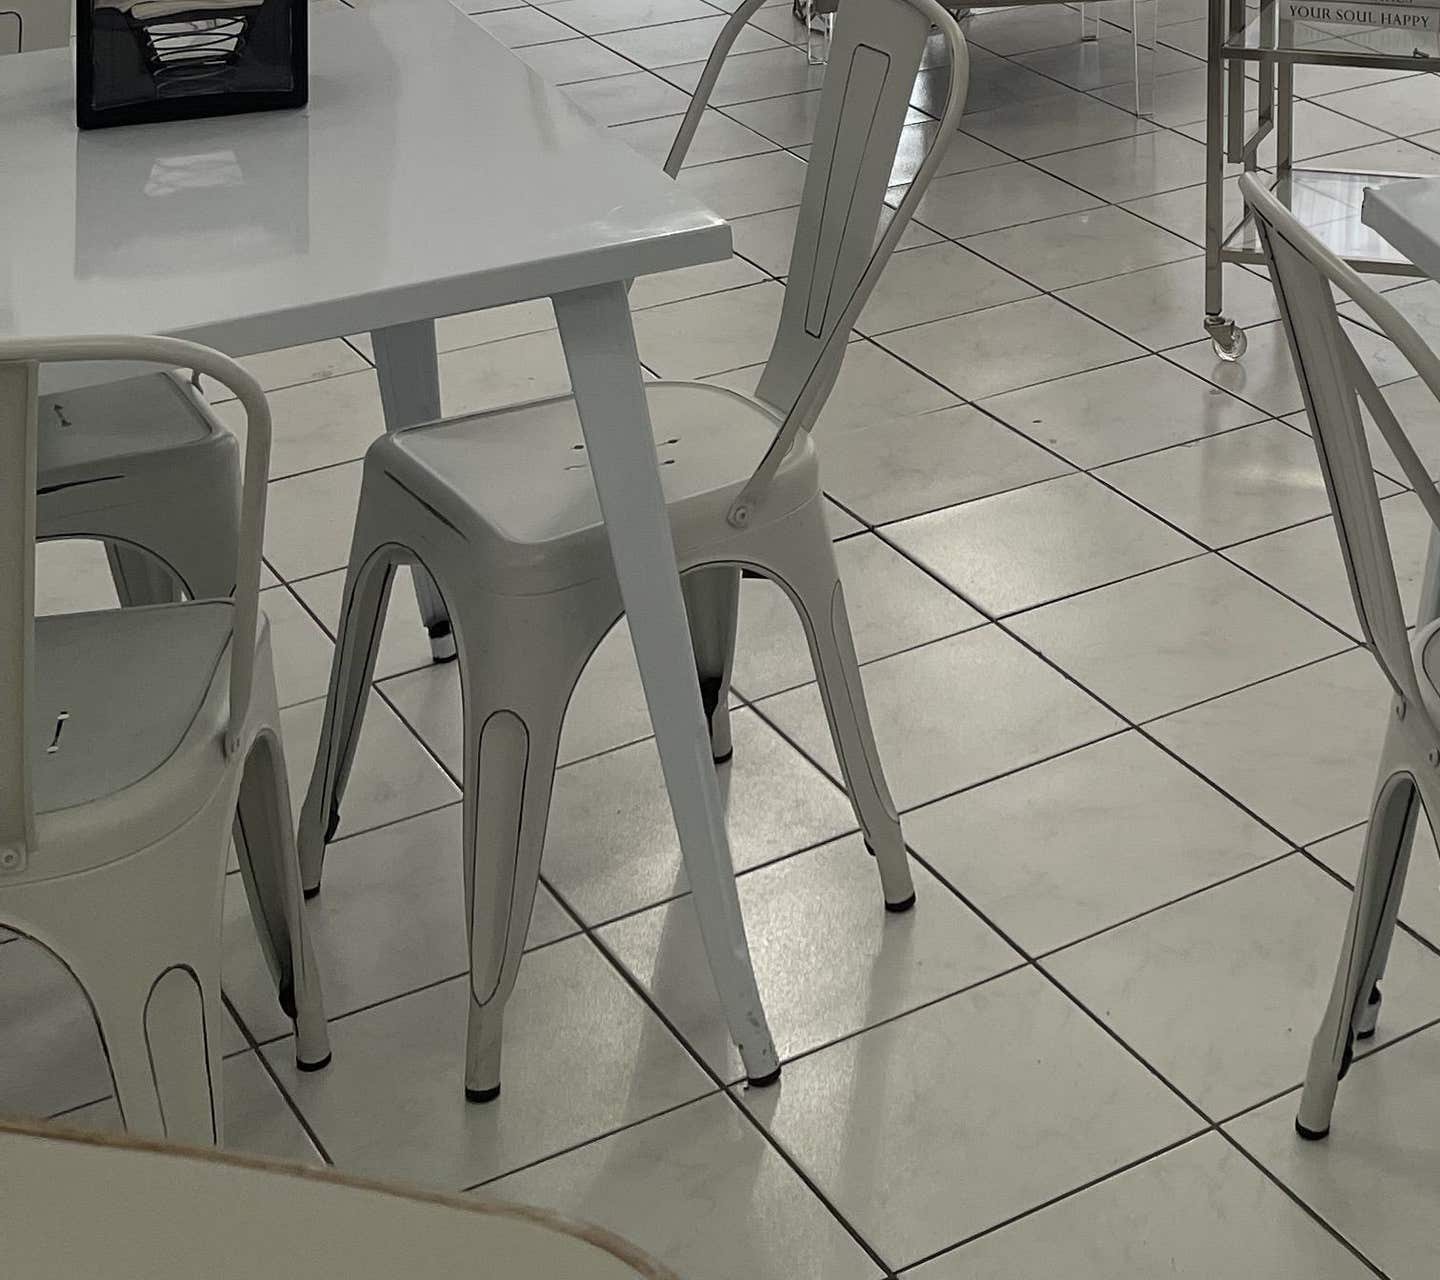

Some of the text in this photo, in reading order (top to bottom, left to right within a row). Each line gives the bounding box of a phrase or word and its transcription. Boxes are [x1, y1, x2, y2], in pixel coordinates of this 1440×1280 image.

[1289, 5, 1430, 28] YOUR SOUL HAPPY
